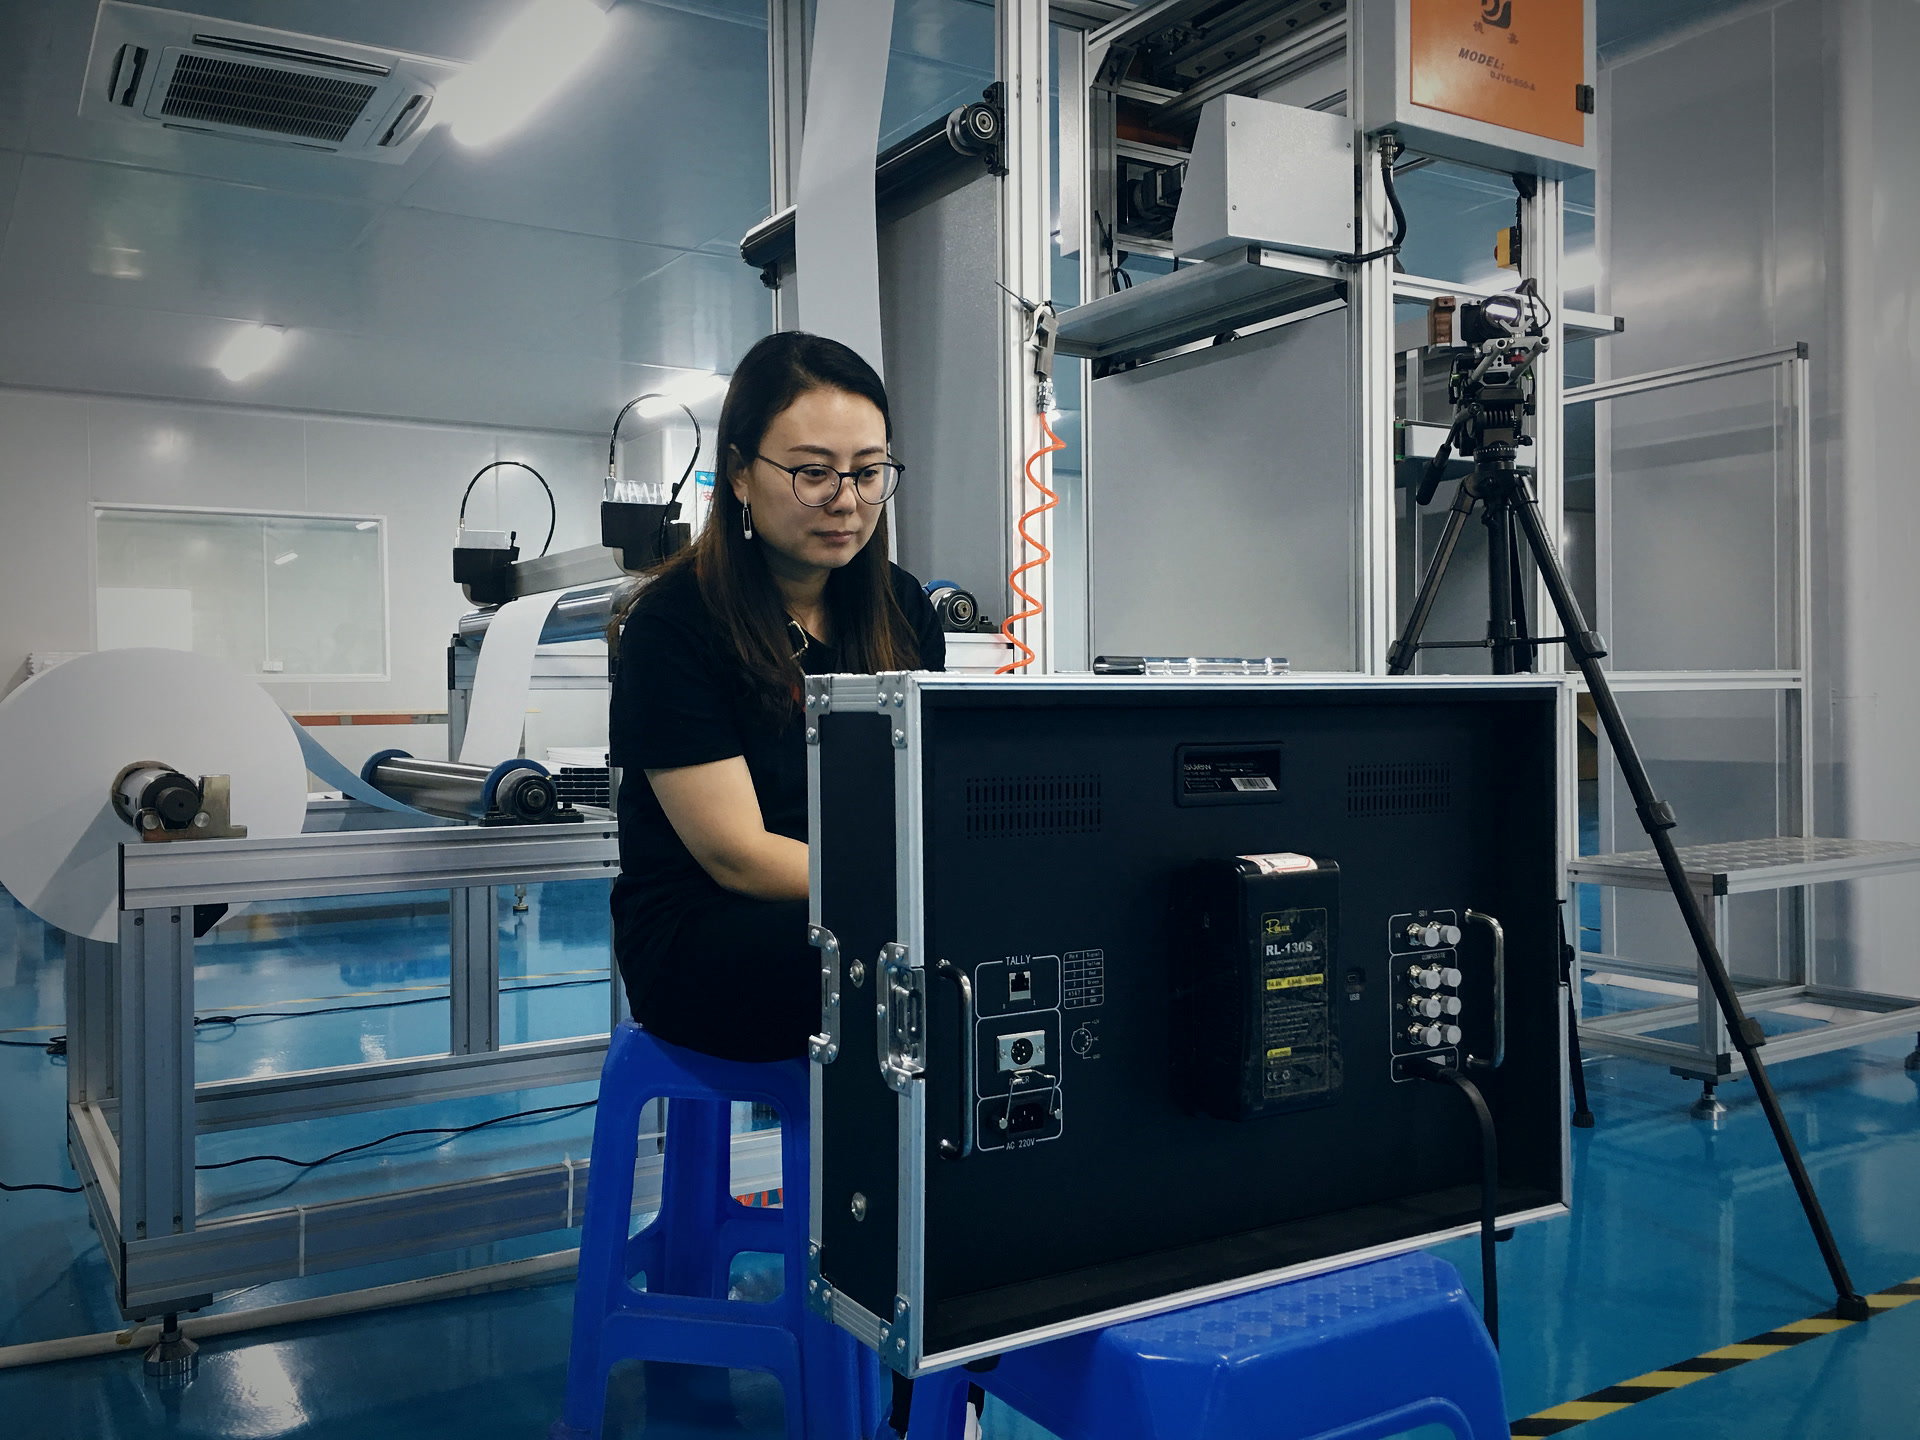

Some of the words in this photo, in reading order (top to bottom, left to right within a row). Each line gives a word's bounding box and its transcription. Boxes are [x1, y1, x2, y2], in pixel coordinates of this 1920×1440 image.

[1458, 48, 1505, 71] MODEL:
[1266, 941, 1313, 956] RL-130S
[1005, 954, 1031, 966] TALLY
[1006, 1141, 1015, 1150] AC
[1018, 1137, 1036, 1148] 220V
